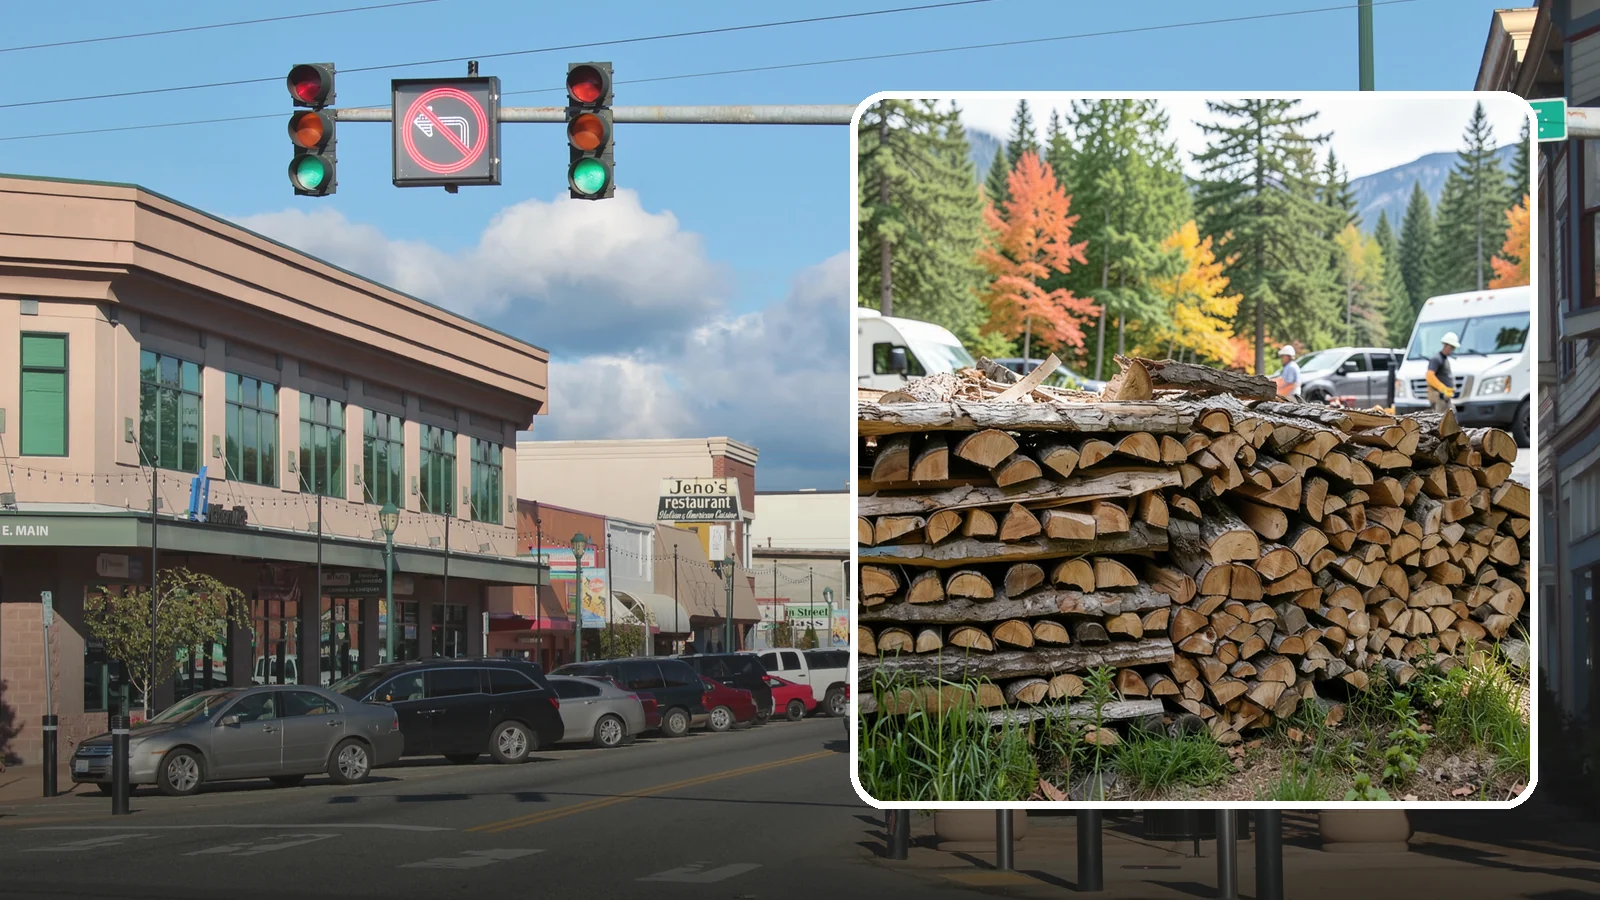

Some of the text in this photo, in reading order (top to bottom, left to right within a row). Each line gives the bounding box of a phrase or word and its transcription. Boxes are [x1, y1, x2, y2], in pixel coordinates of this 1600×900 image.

[670, 480, 727, 494] Jeno's
[665, 496, 731, 509] restaurant
[658, 510, 681, 520] Italian
[686, 510, 714, 519] American
[715, 509, 737, 519] Cuisine
[2, 525, 49, 536] E. MAIN
[797, 607, 828, 617] Street
